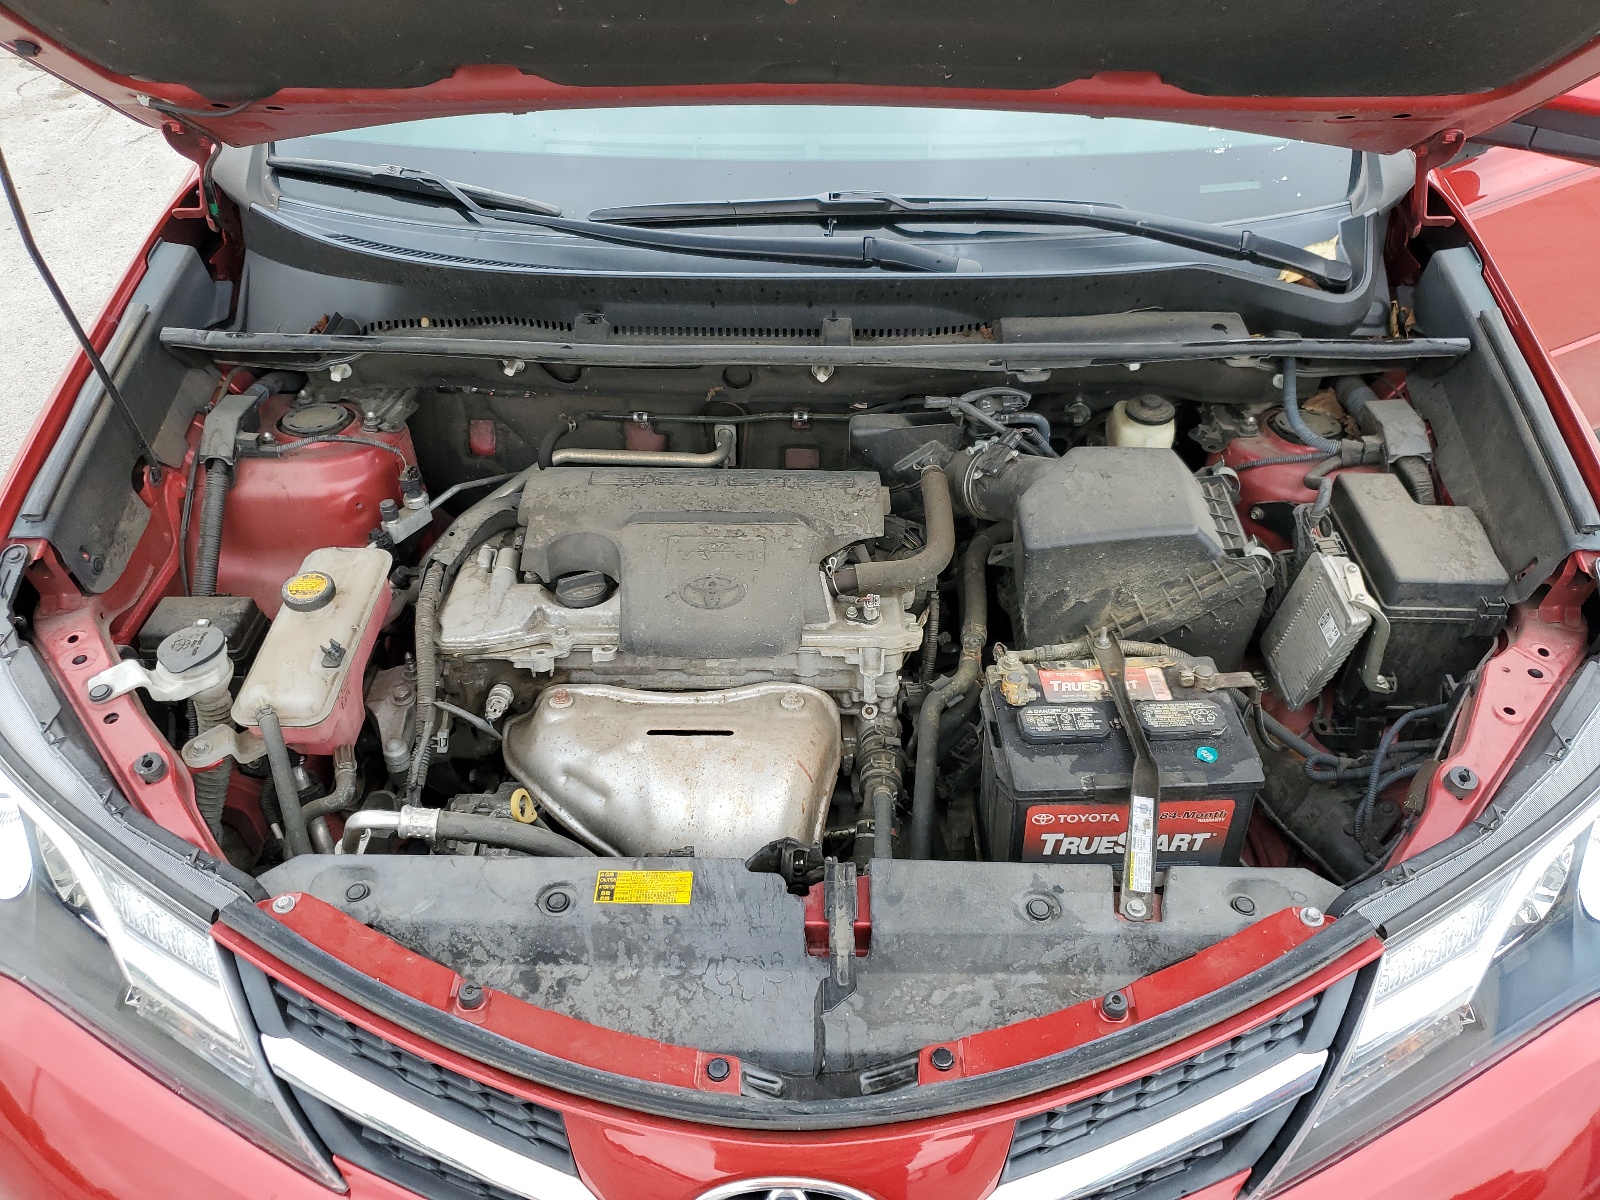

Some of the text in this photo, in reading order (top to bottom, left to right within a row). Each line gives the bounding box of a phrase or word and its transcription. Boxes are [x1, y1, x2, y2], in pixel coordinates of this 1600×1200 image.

[1057, 813, 1120, 824] TOYOTA
[1159, 809, 1229, 821] 84-Month
[1040, 831, 1212, 856] TRUESART
